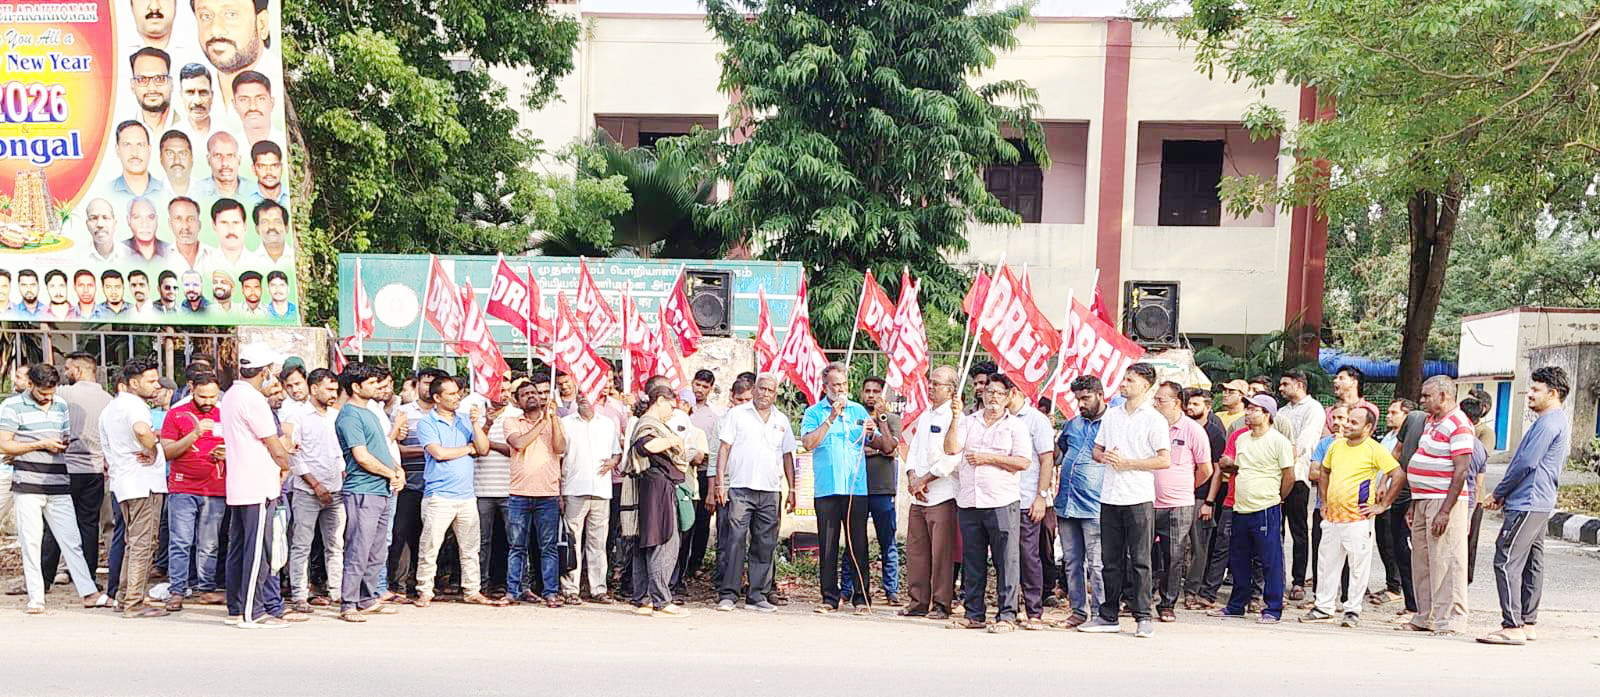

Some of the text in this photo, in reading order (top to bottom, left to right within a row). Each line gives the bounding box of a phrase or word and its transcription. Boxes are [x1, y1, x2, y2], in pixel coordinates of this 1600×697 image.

[0, 4, 97, 21] H-ARAKKONAM
[5, 29, 73, 48] You All a
[7, 53, 90, 71] New Year
[0, 81, 69, 123] 026
[982, 274, 1050, 383] DREU
